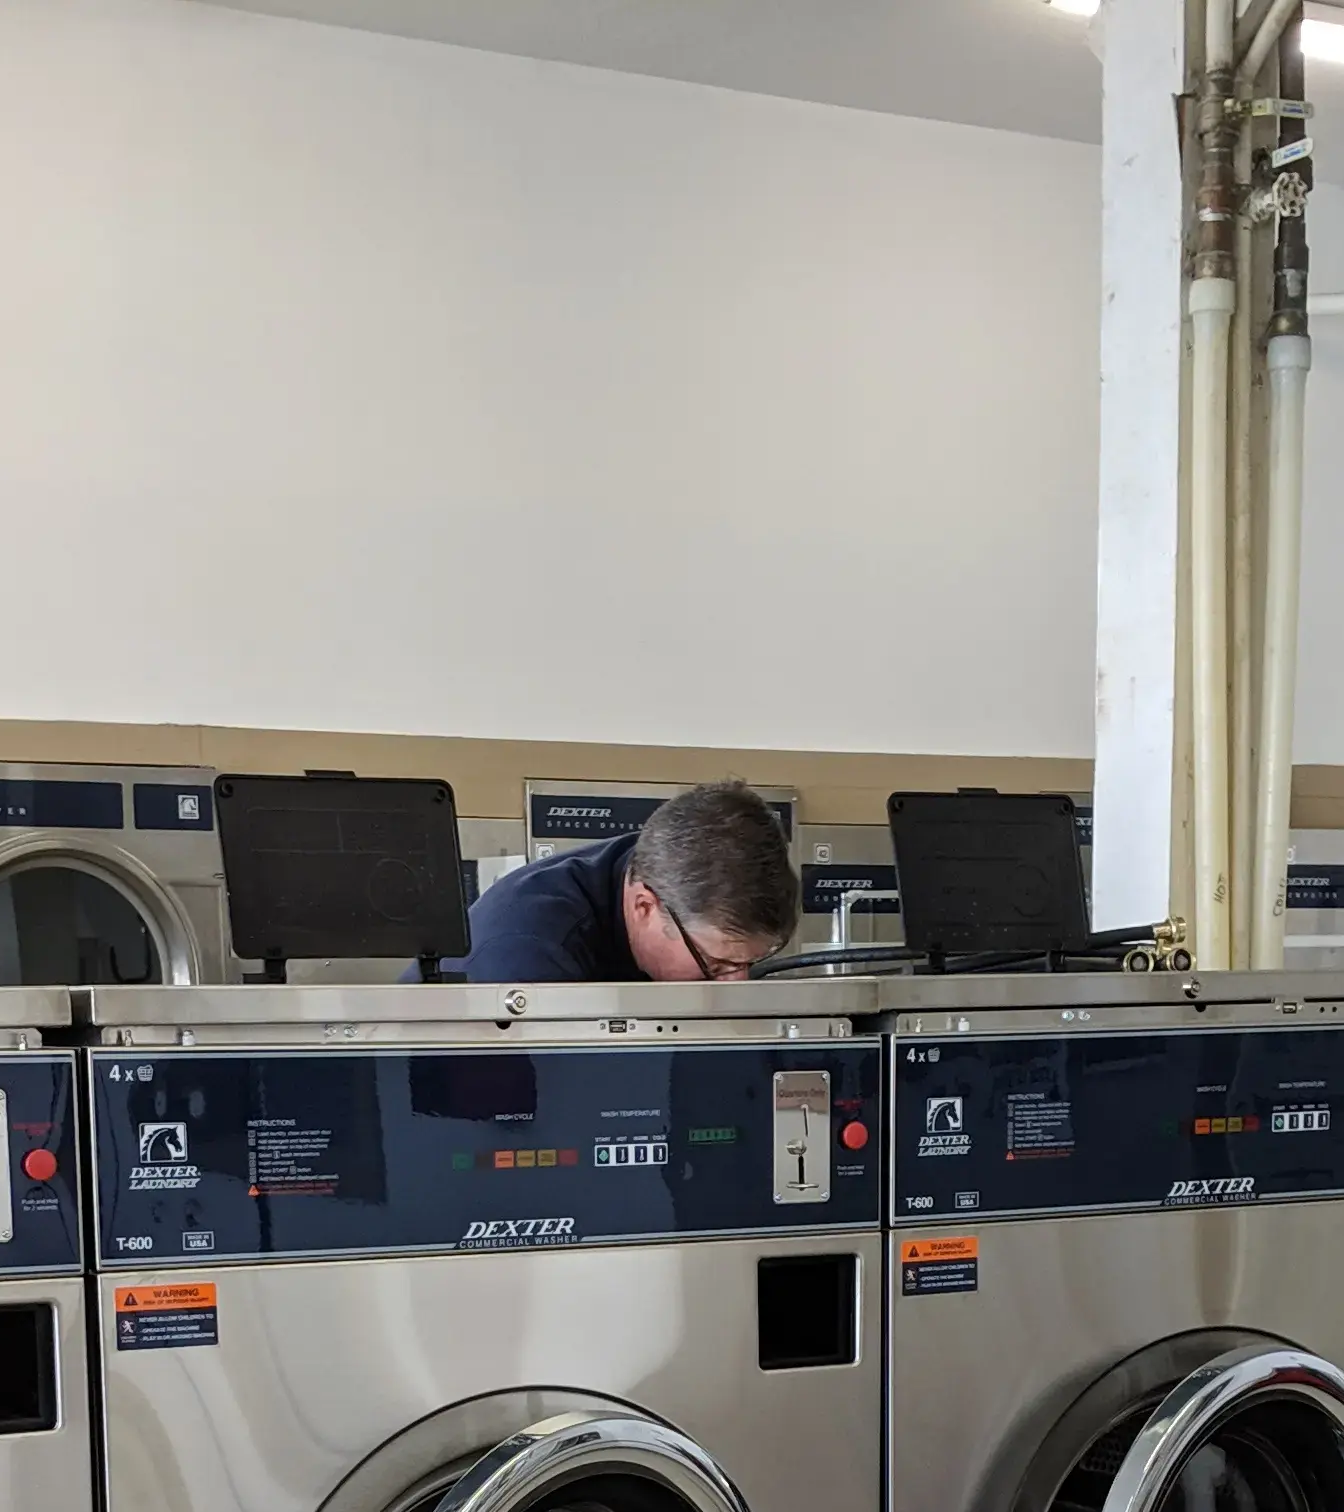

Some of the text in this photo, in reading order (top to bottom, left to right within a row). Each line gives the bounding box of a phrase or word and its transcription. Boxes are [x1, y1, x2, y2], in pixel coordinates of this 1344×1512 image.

[547, 806, 612, 818] DEXTER
[815, 879, 874, 888] DEXTER
[1212, 872, 1226, 904] HOT
[247, 1119, 296, 1127] INSTRUCTIONS
[918, 1134, 972, 1147] DEXTER
[917, 1146, 971, 1157] LAUNDRY
[129, 1166, 201, 1178] DEXTER
[129, 1178, 201, 1190] LAUNDRY
[1167, 1177, 1255, 1197] DEXTER
[906, 1196, 934, 1209] T-600
[1164, 1192, 1256, 1206] COMMERCIAL WASHER
[462, 1217, 575, 1239] DEXTER
[116, 1236, 153, 1250] T-600
[190, 1239, 207, 1248] USA
[459, 1234, 578, 1249] COMMERCIAL WASHER
[153, 1288, 199, 1299] WARNING
